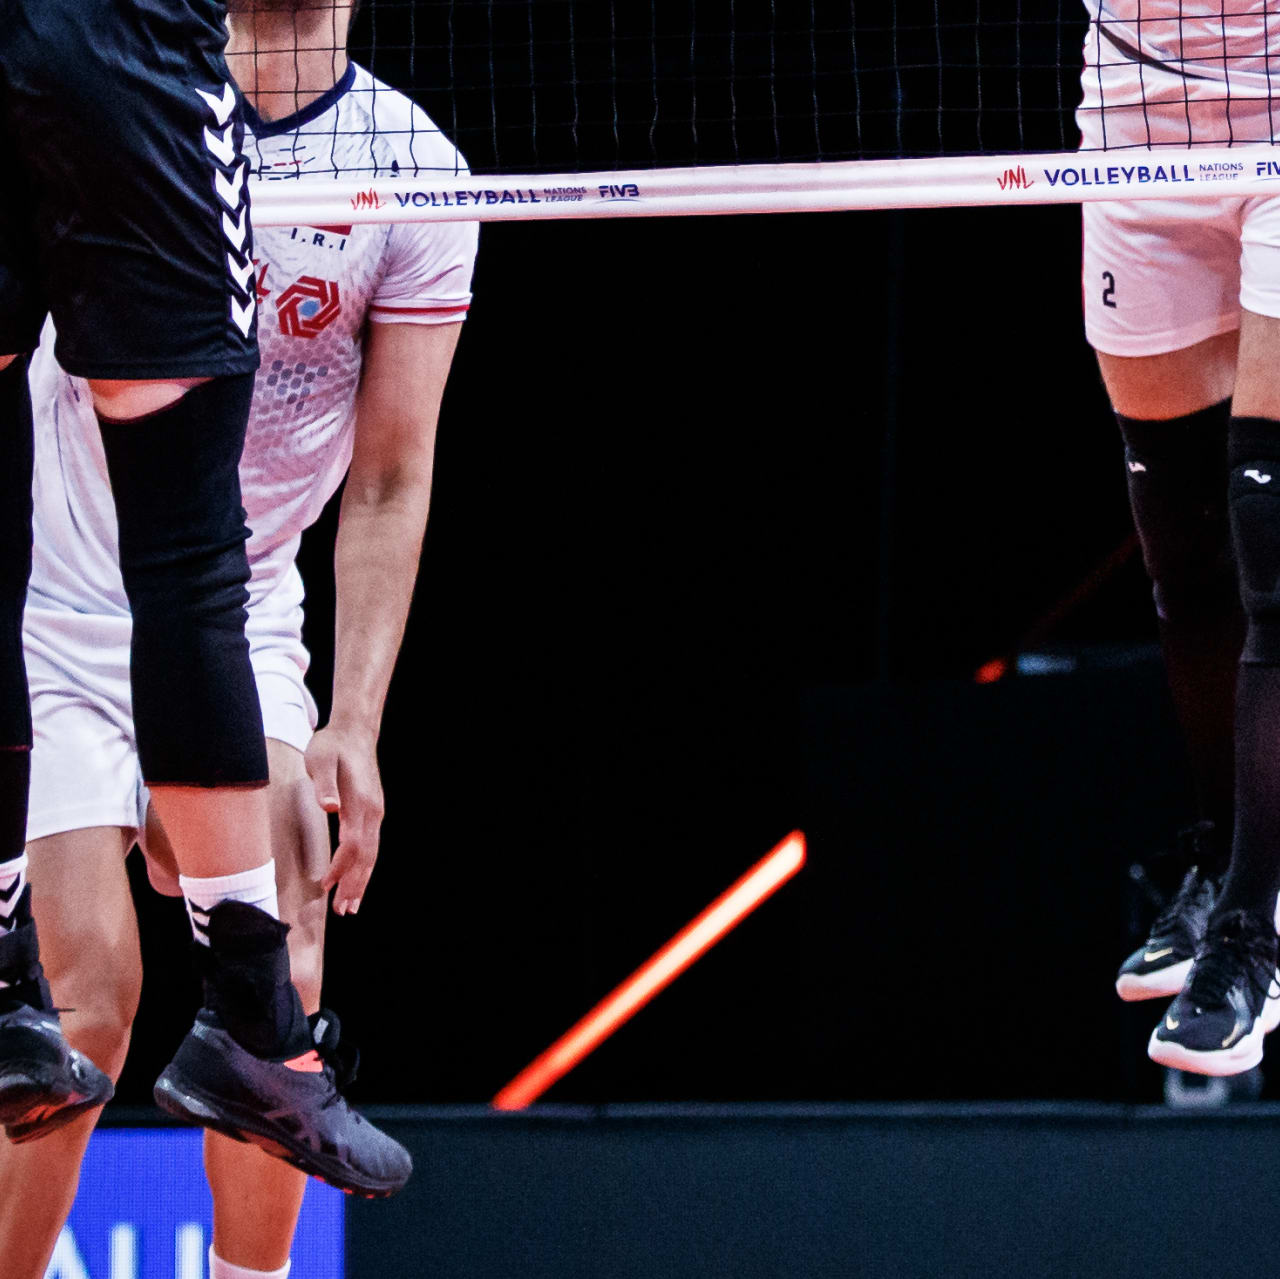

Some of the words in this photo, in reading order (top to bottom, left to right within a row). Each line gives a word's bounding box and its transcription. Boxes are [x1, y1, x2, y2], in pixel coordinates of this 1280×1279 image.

[1199, 162, 1244, 172] NATIONS
[996, 164, 1035, 190] VNL
[1043, 164, 1195, 187] VOLLEYBALL
[1200, 172, 1239, 182] LEAGUE
[350, 187, 387, 211] VNL
[394, 188, 542, 208] VOLLEYBALL
[544, 186, 588, 196] NATIONS
[545, 194, 584, 203] LEAGUE
[598, 183, 641, 199] FIVB
[290, 227, 347, 251] I.R.I
[1102, 270, 1118, 309] 2
